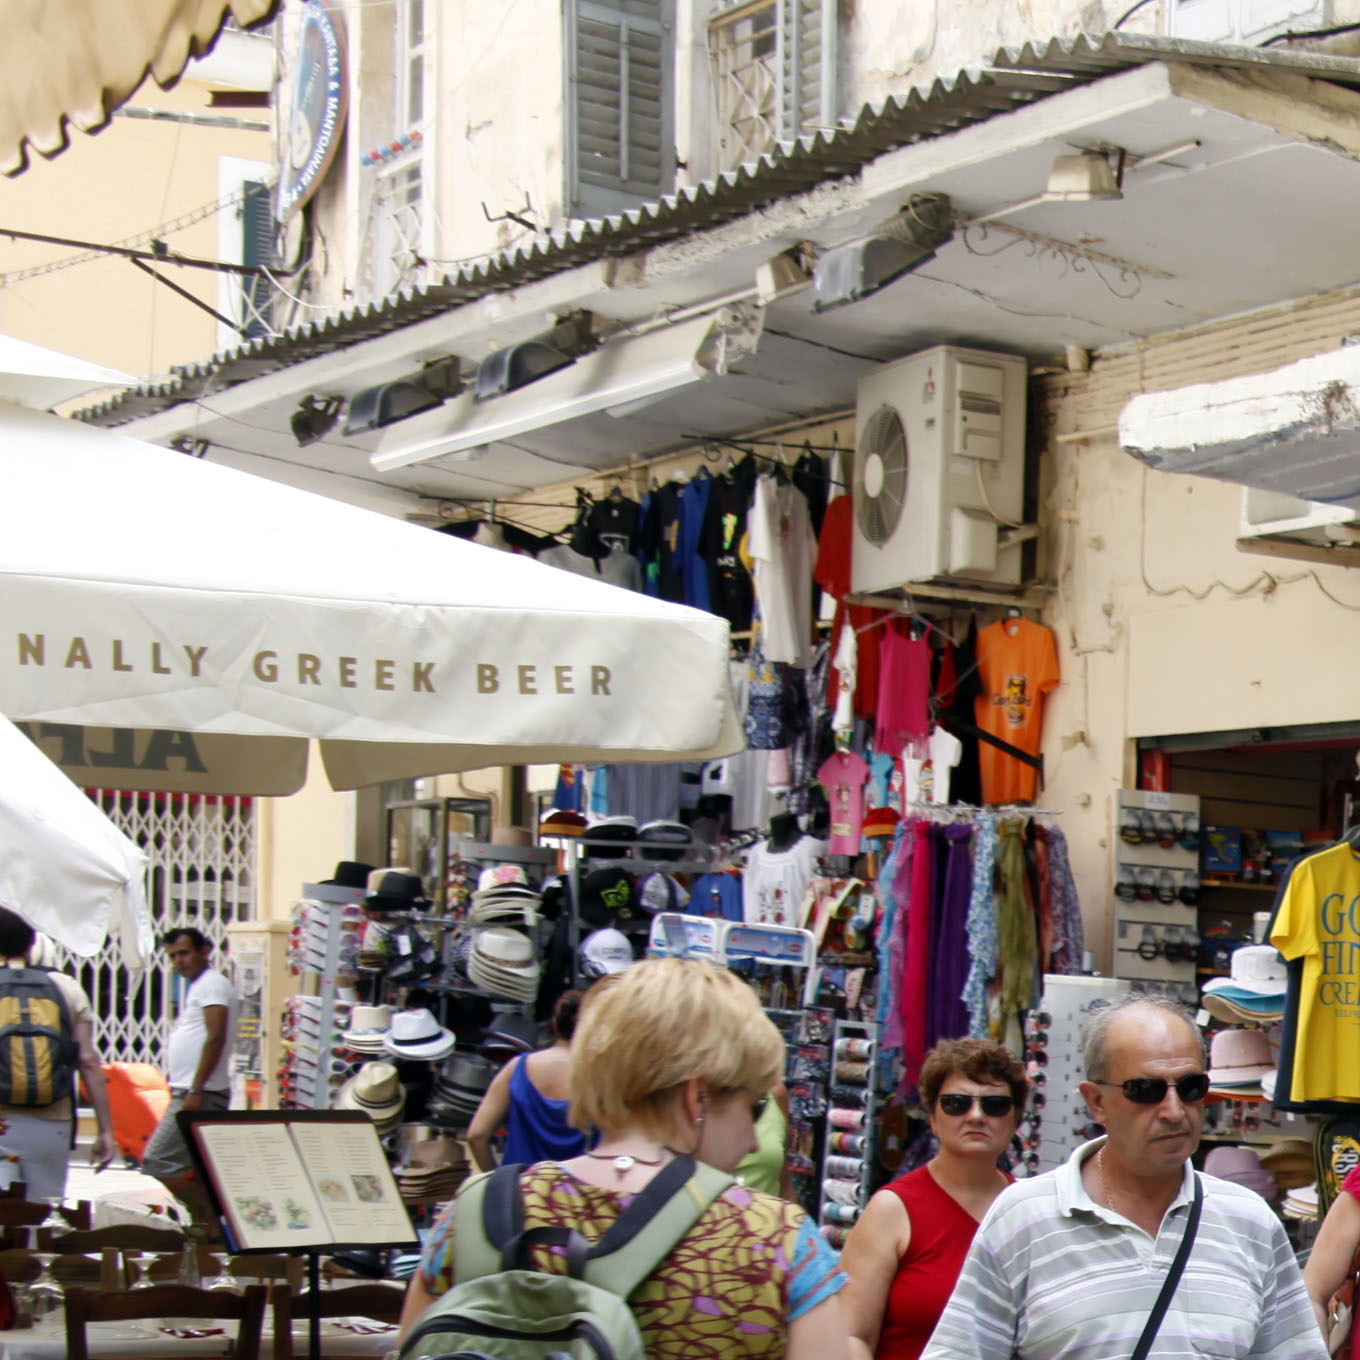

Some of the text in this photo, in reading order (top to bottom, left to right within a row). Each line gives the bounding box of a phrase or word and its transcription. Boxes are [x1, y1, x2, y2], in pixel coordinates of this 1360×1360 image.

[17, 632, 613, 697] NALLY GREEK BEER
